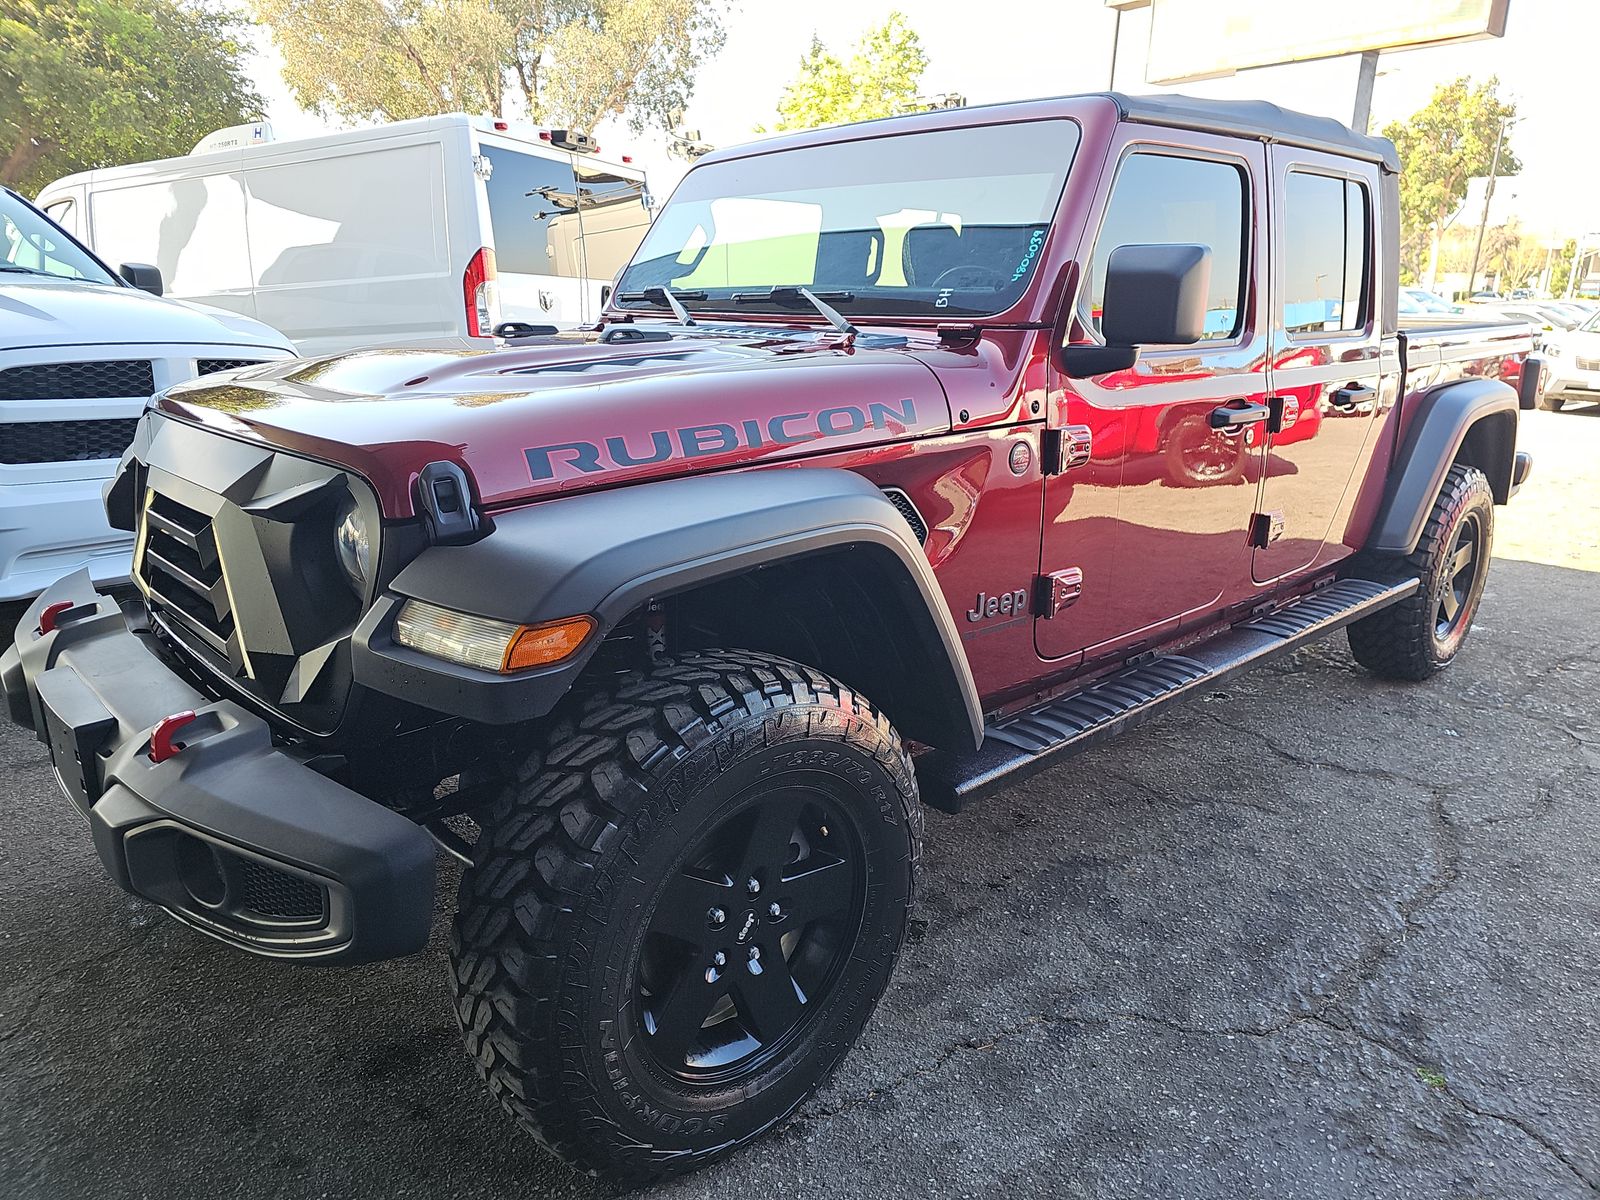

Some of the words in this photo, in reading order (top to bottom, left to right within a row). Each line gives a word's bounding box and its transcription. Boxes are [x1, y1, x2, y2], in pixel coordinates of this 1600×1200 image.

[1010, 229, 1045, 282] 4806039
[935, 288, 954, 308] BH
[522, 398, 918, 482] RUBICON
[966, 588, 1027, 622] Jeep
[738, 913, 755, 940] Jeep
